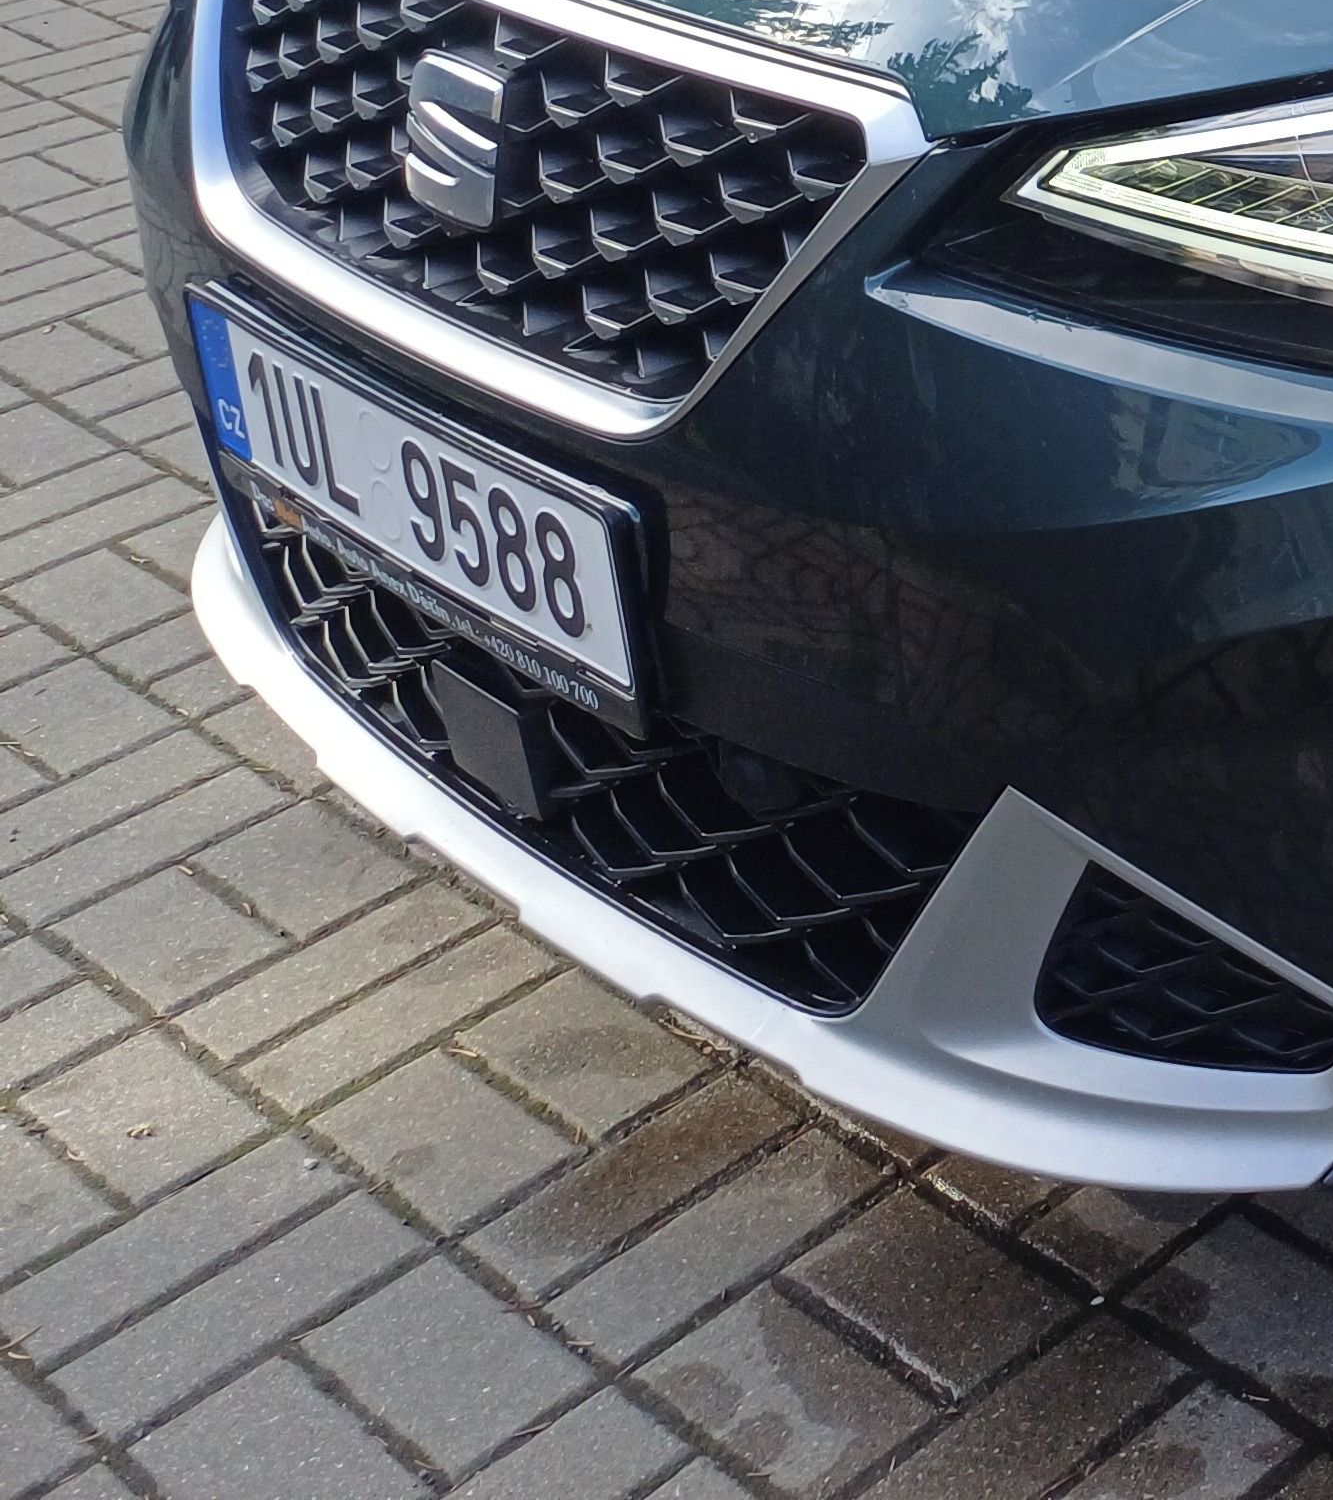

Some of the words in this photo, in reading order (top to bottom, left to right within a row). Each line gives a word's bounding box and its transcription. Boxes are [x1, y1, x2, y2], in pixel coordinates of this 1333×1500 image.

[217, 396, 247, 439] CZ
[247, 350, 360, 517] 1UL
[400, 438, 587, 639] 9588
[515, 649, 542, 679] 810
[543, 665, 570, 695] 100
[569, 680, 600, 711] 700
